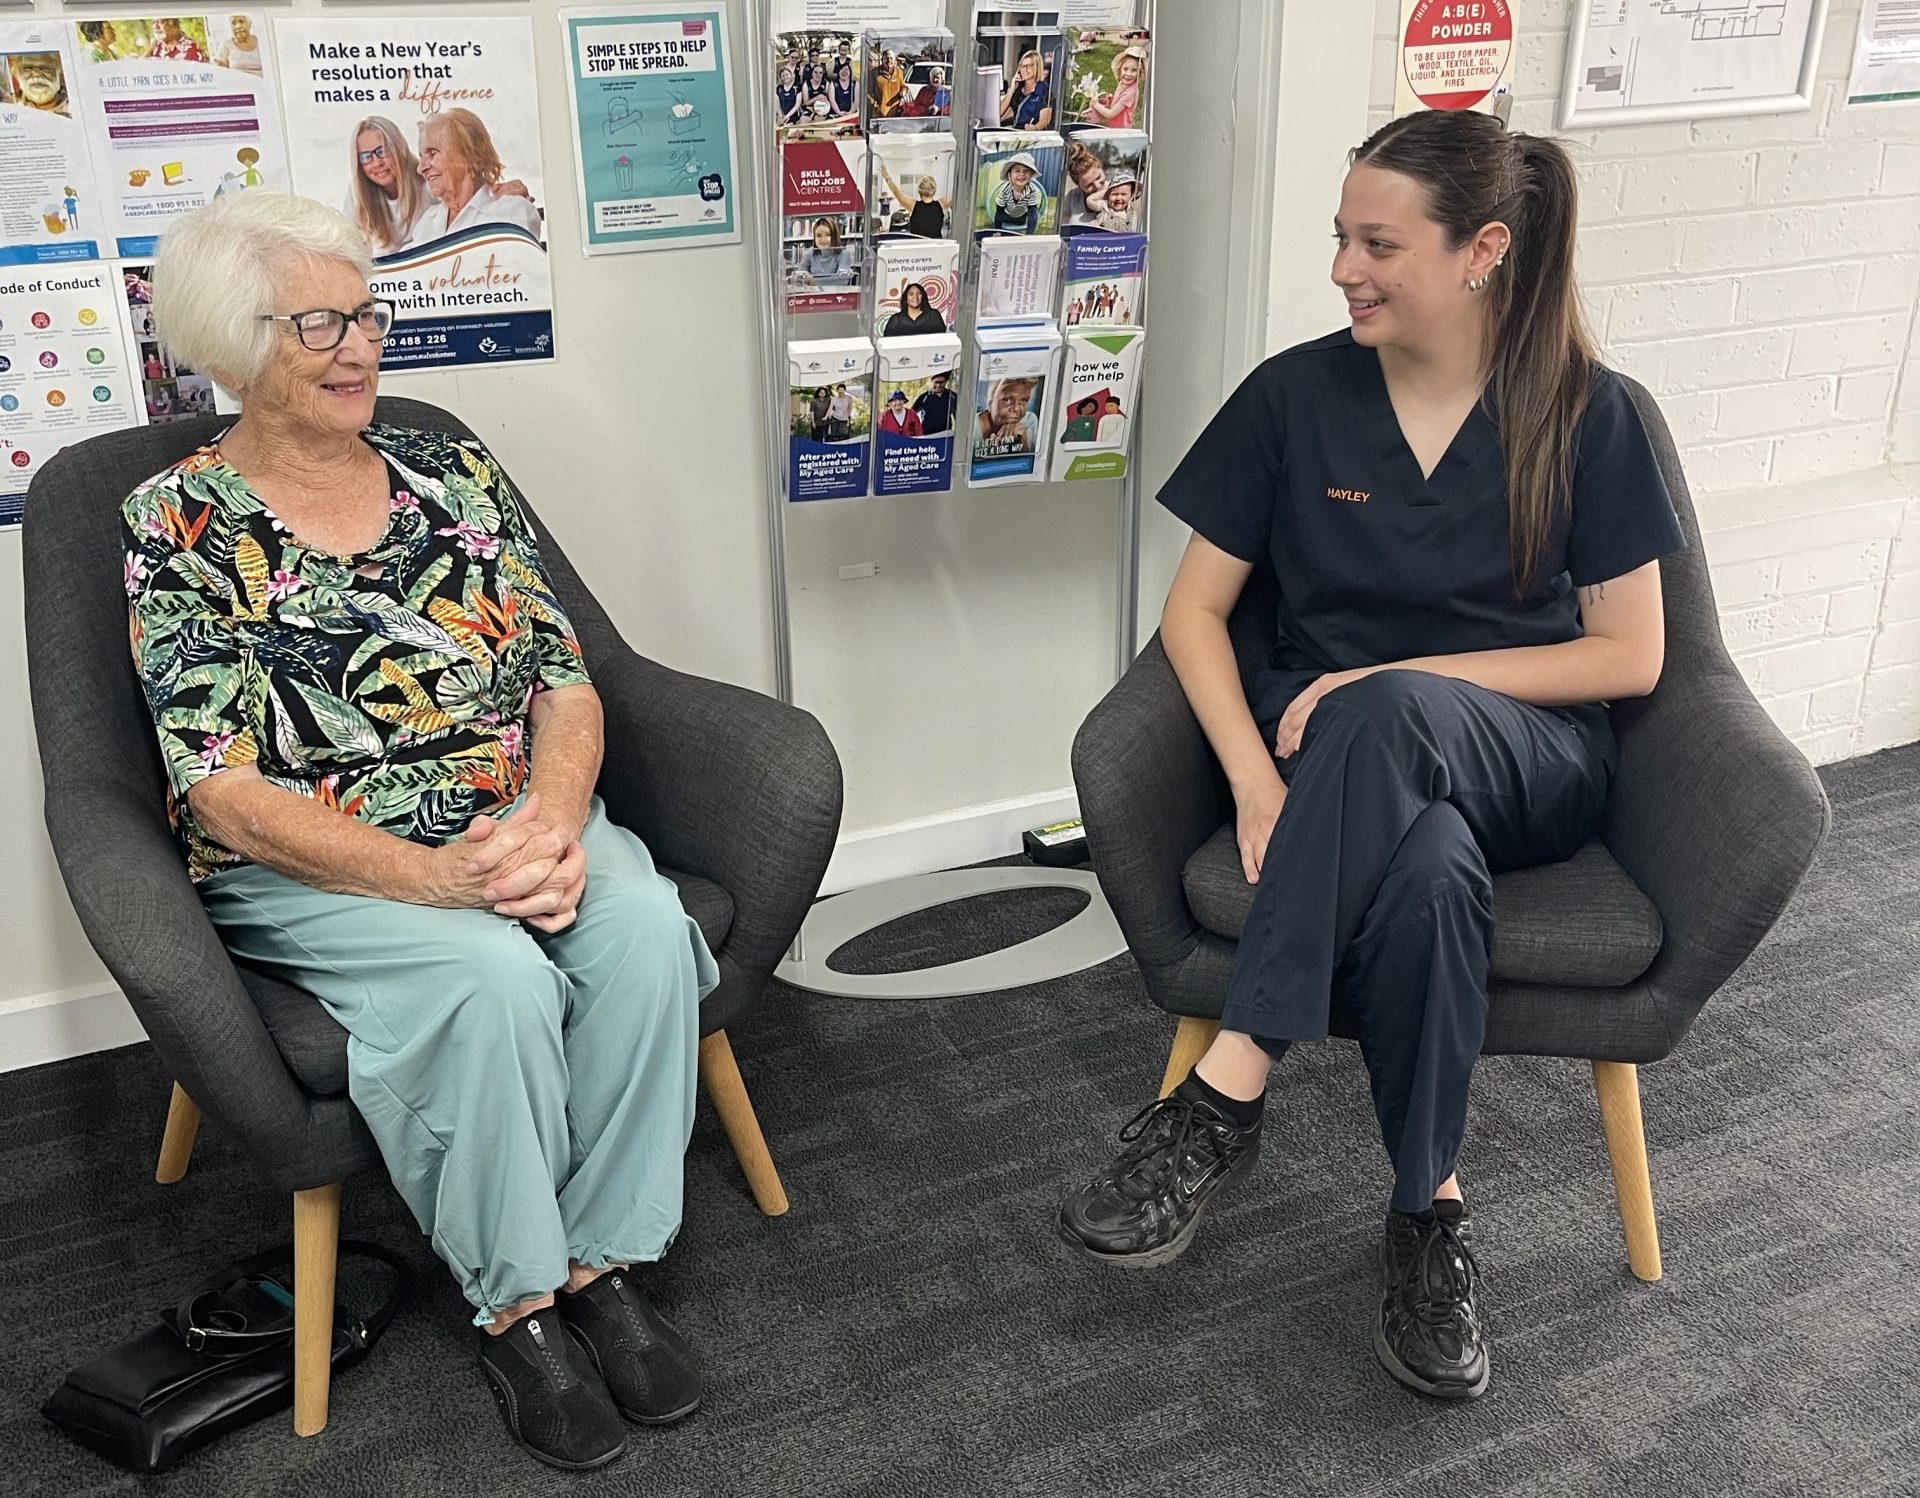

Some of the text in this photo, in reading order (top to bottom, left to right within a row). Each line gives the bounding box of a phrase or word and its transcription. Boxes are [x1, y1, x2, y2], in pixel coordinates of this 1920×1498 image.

[1413, 2, 1429, 23] THIS
[1441, 3, 1486, 21] A:B(E)
[1431, 22, 1492, 39] POWDER
[309, 41, 482, 60] Make a New Year’s
[587, 40, 707, 58] SIMPLE STEPS TO HELP
[1414, 53, 1423, 62] TO
[1425, 52, 1434, 61] BE
[1437, 50, 1456, 60] USED
[1458, 49, 1473, 59] FOR
[588, 55, 688, 72] STOP THE SPREAD.
[1418, 61, 1443, 70] WOOD,
[1446, 58, 1476, 68] TEXTILE,
[312, 63, 452, 81] resolution that
[1410, 66, 1499, 81] LIQUID, AND ELECTRICAL
[107, 75, 129, 88] LITTLE
[133, 75, 150, 87] YARN
[199, 73, 214, 83] WAY
[1444, 78, 1465, 88] FIRES
[314, 70, 494, 114] makes a difference
[3, 113, 18, 124] WAY
[800, 169, 830, 178] SKILLS
[703, 181, 719, 190] STOP
[800, 177, 846, 187] AND JOBS
[800, 186, 842, 195] CENTRES
[156, 202, 174, 210] 1800
[1076, 245, 1126, 254] Family Carers
[369, 253, 522, 294] ome a volunteer
[915, 264, 942, 273] support
[991, 258, 999, 279] OPAN
[0, 276, 101, 294] ode of Conduct
[399, 288, 528, 309] with Intereach.
[382, 334, 447, 347] 00 488 226
[1073, 361, 1120, 373] how we
[1072, 371, 1125, 383] can help
[884, 445, 936, 456] Find the help
[1011, 443, 1024, 452] WAY
[799, 450, 848, 462] After you’ve
[884, 453, 940, 465] you need with
[799, 457, 860, 470] registered with
[884, 462, 940, 474] My Aged Care
[799, 466, 855, 478] My Aged Care
[1327, 487, 1370, 503] HAYLEY
